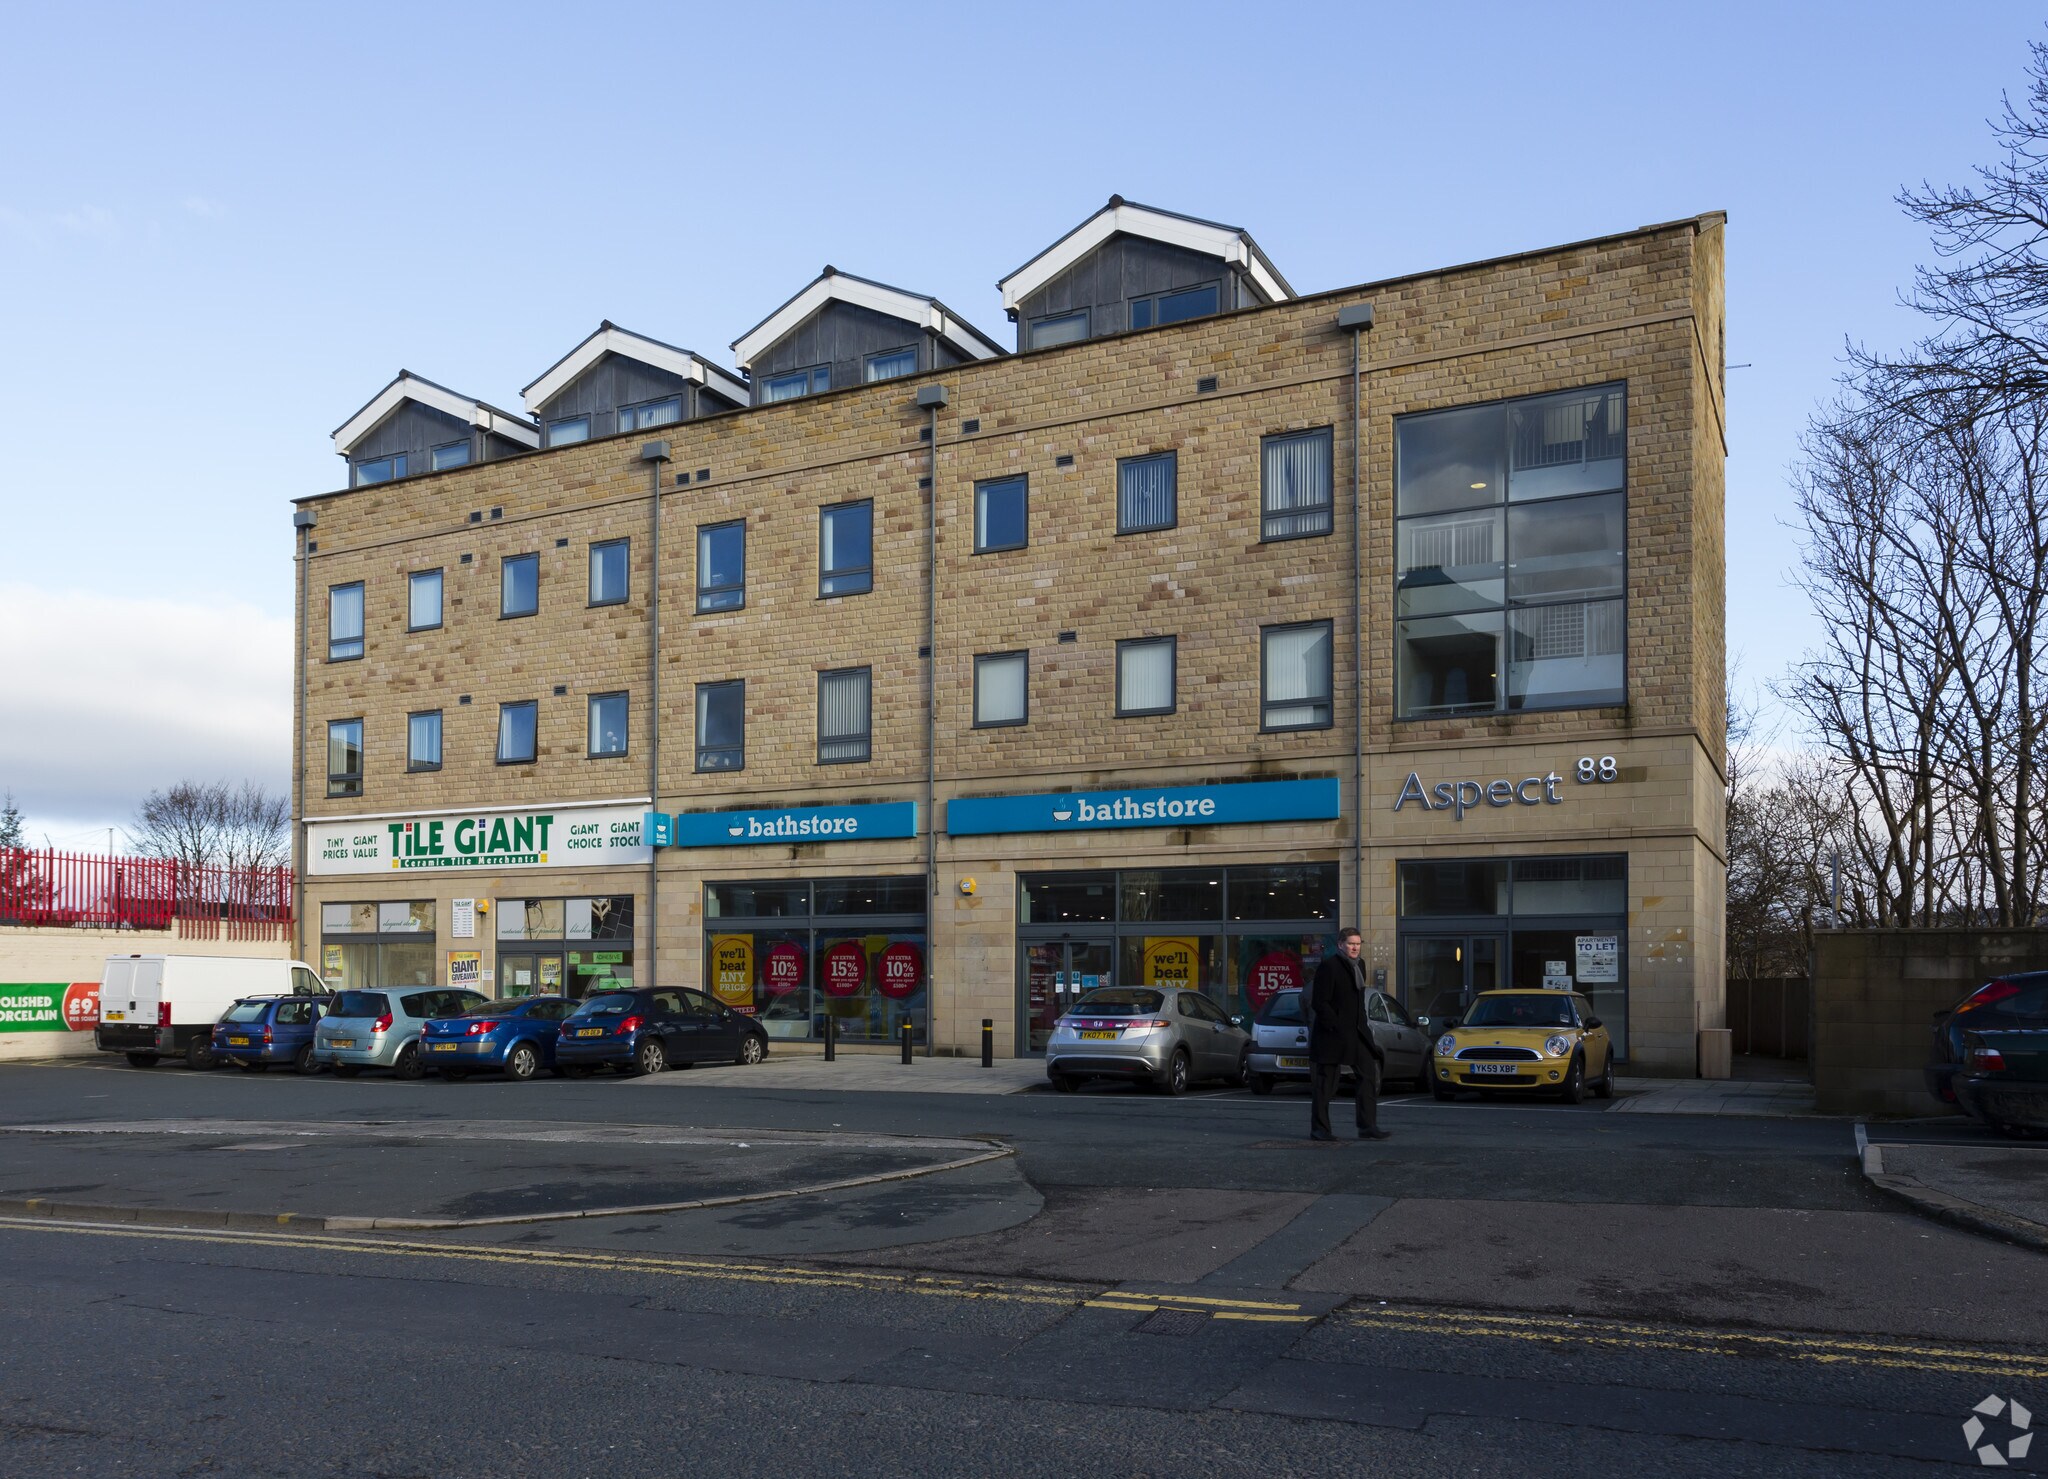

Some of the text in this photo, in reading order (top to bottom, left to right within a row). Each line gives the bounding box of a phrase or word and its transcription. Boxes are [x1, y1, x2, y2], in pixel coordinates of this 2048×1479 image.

[1394, 756, 1618, 821] Aspect 88
[1077, 796, 1216, 822] bathstore
[747, 815, 858, 838] bathstore
[567, 838, 602, 849] CHOICE
[609, 836, 641, 848] STOCK
[323, 849, 348, 860] PRICES
[353, 848, 378, 858] VALUE
[404, 854, 535, 868] Ceramic Tile Merchants
[1577, 943, 1616, 951] TO LET
[1154, 952, 1189, 964] we'll
[452, 960, 479, 973] GIANT
[542, 963, 560, 972] GIANT
[720, 960, 746, 971] beat
[771, 961, 797, 976] 10%
[831, 961, 858, 977] 15%
[886, 961, 914, 977] 10%
[452, 972, 479, 981] GIVEAWAY
[720, 972, 746, 982] ANY
[1153, 966, 1189, 978] beat
[720, 983, 746, 992] PRICE
[1258, 973, 1293, 990] 15%
[0, 996, 52, 1008] OLISHED
[0, 1010, 57, 1022] ORCELAIN
[1083, 1031, 1116, 1039] YK07 YRA
[1476, 1064, 1516, 1073] YK59 XBF
